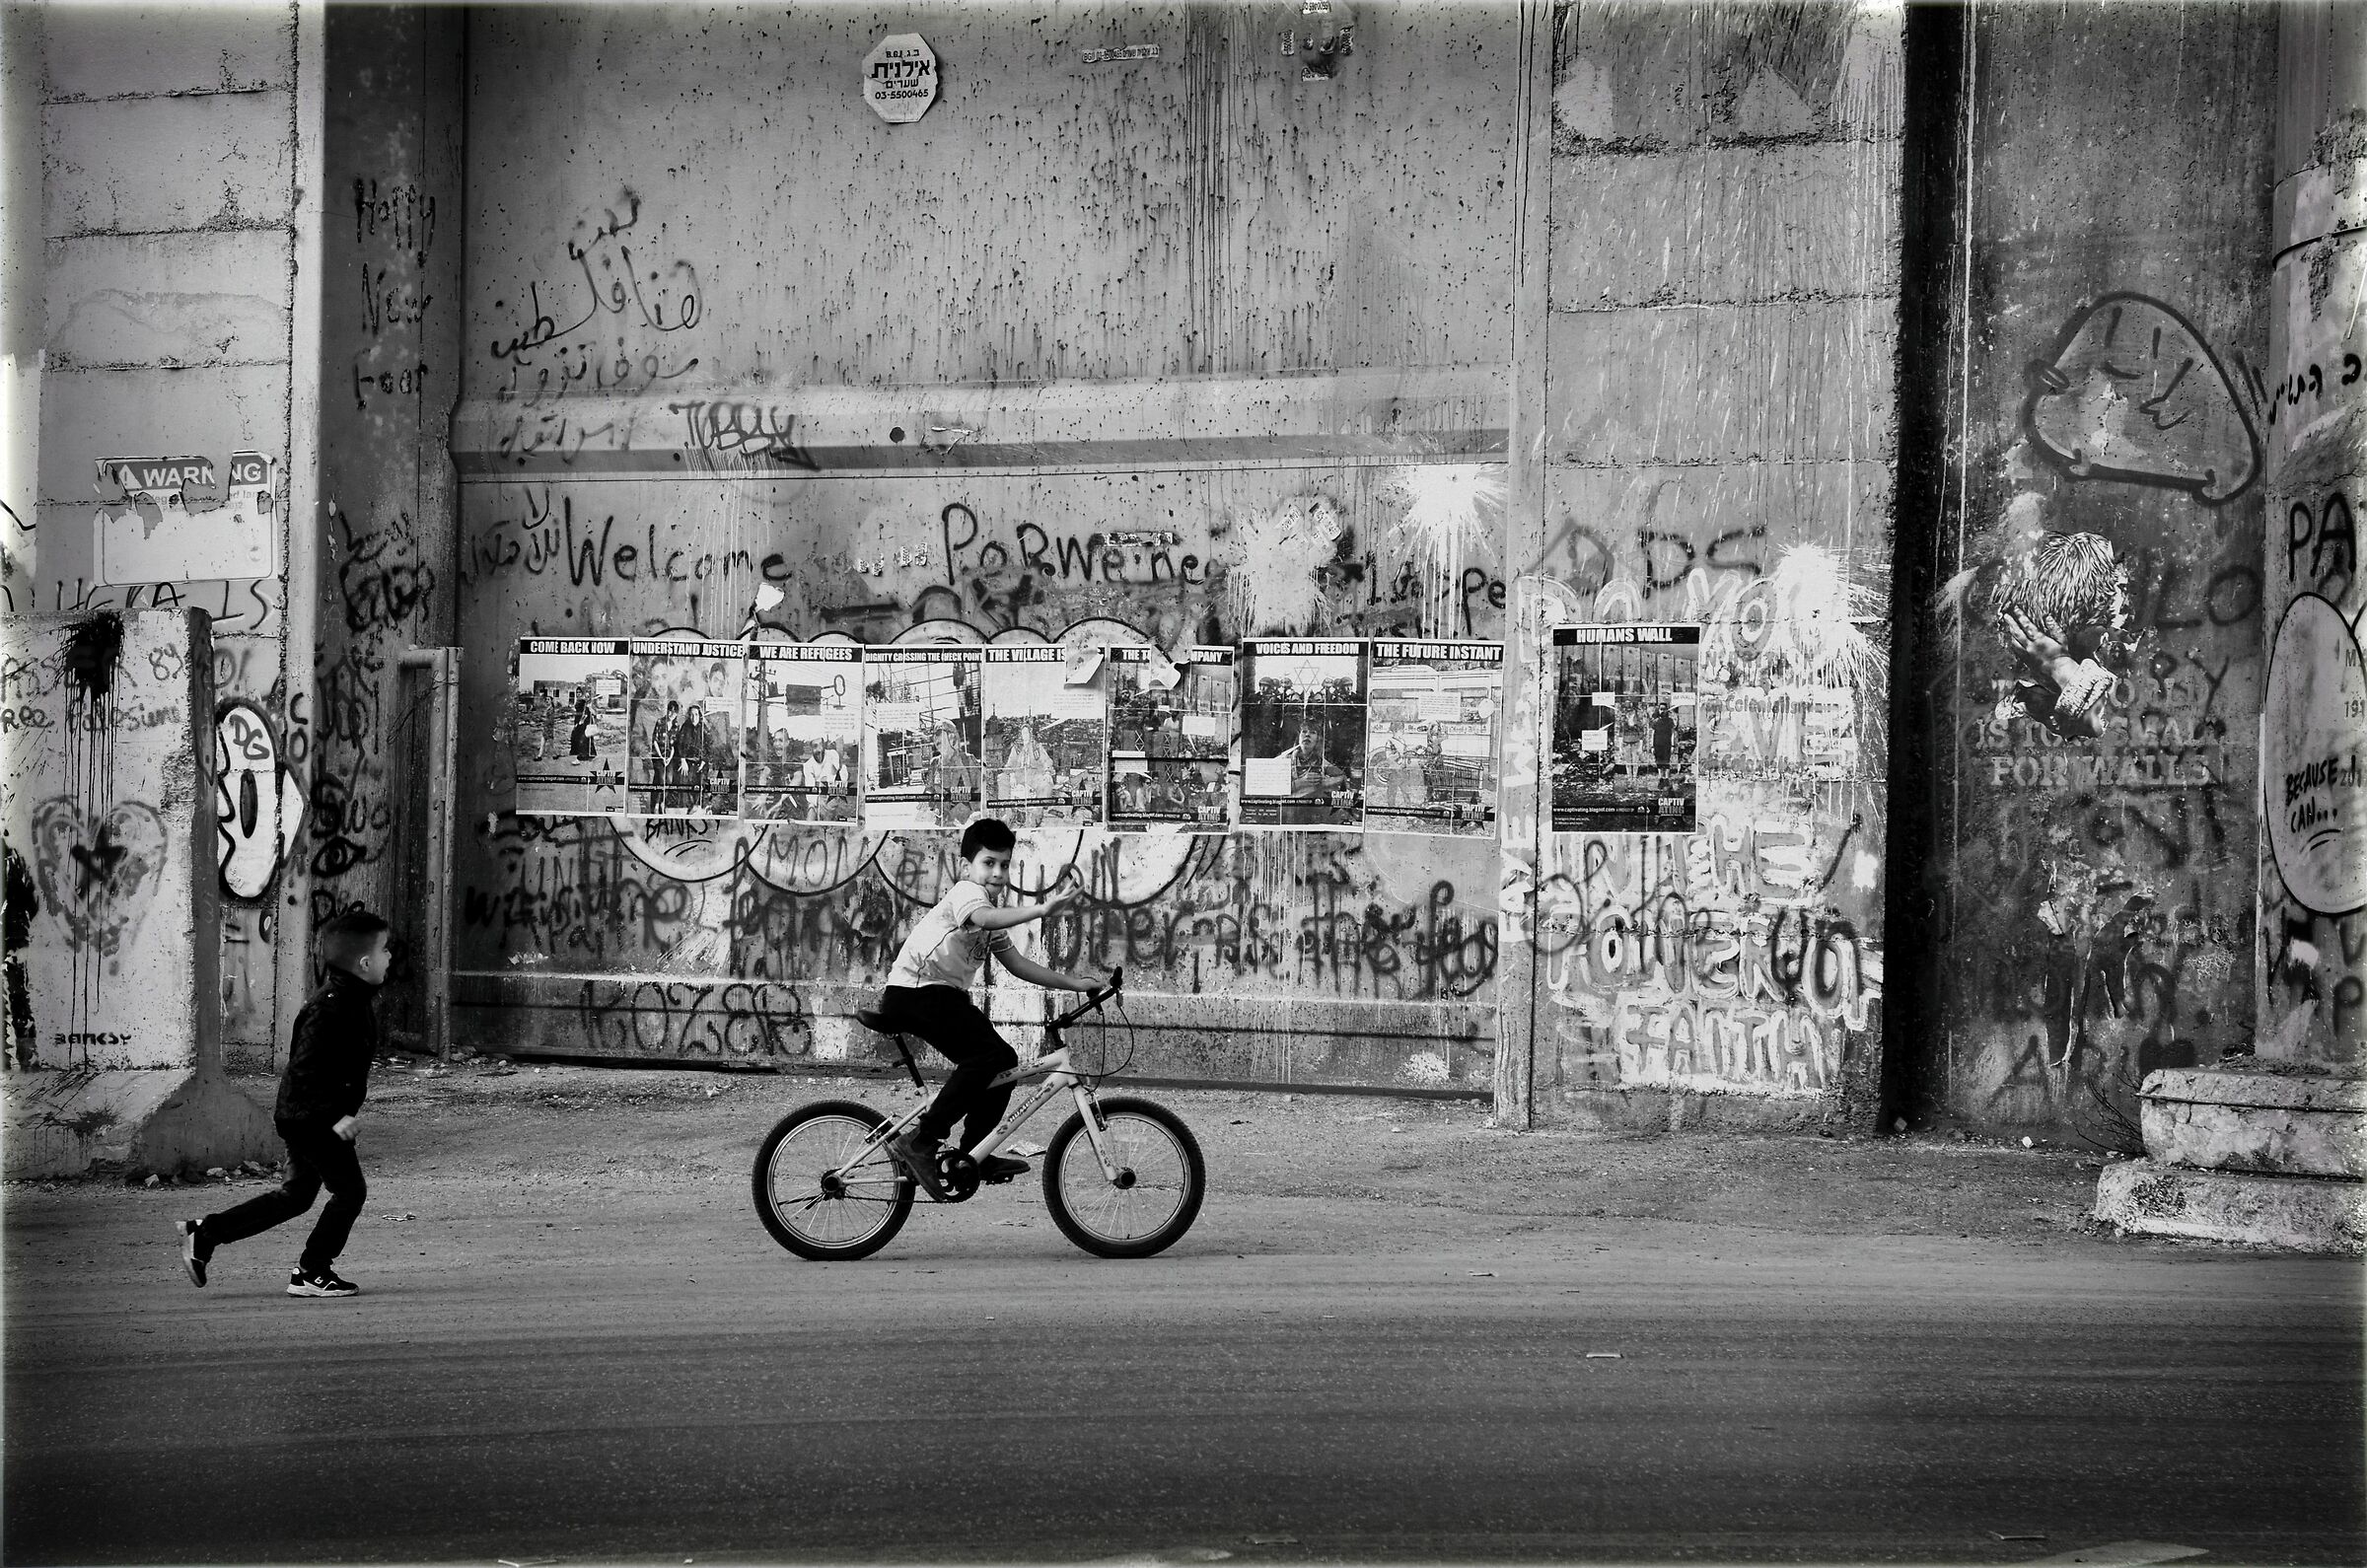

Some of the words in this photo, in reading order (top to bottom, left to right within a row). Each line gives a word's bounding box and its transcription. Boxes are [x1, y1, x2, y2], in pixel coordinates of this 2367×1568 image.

[871, 59, 931, 79] אילנית
[885, 79, 919, 89] שערים
[874, 88, 929, 100] 03-5500465
[143, 462, 261, 488] WARNNG
[564, 496, 791, 586] Welcome
[1576, 627, 1635, 643] HUMANS
[1636, 626, 1673, 642] WALL
[530, 640, 559, 654] COME
[560, 640, 590, 654] BACK
[632, 641, 700, 656] UNDERSTAND
[701, 643, 744, 659] JUSTICE
[1291, 642, 1314, 654] AND
[1315, 642, 1360, 654] FREEDOM
[1376, 643, 1399, 658] THE
[1401, 644, 1448, 659] FUTURE
[758, 646, 777, 659] WE
[778, 646, 799, 660] ARE
[800, 647, 853, 661] REFUGEES
[865, 652, 893, 663] DIGNITY
[927, 652, 941, 663] THE
[988, 649, 1010, 662] THE
[1010, 649, 1055, 662] VILLAGE
[1121, 649, 1140, 661] THE
[1989, 754, 2069, 786] FOR
[1330, 790, 1355, 799] CAPTIV
[1657, 797, 1686, 806] CAPTIV
[1197, 805, 1221, 814] CAPTIV
[1461, 804, 1485, 813] CAPTIV
[1657, 806, 1686, 815] ATING
